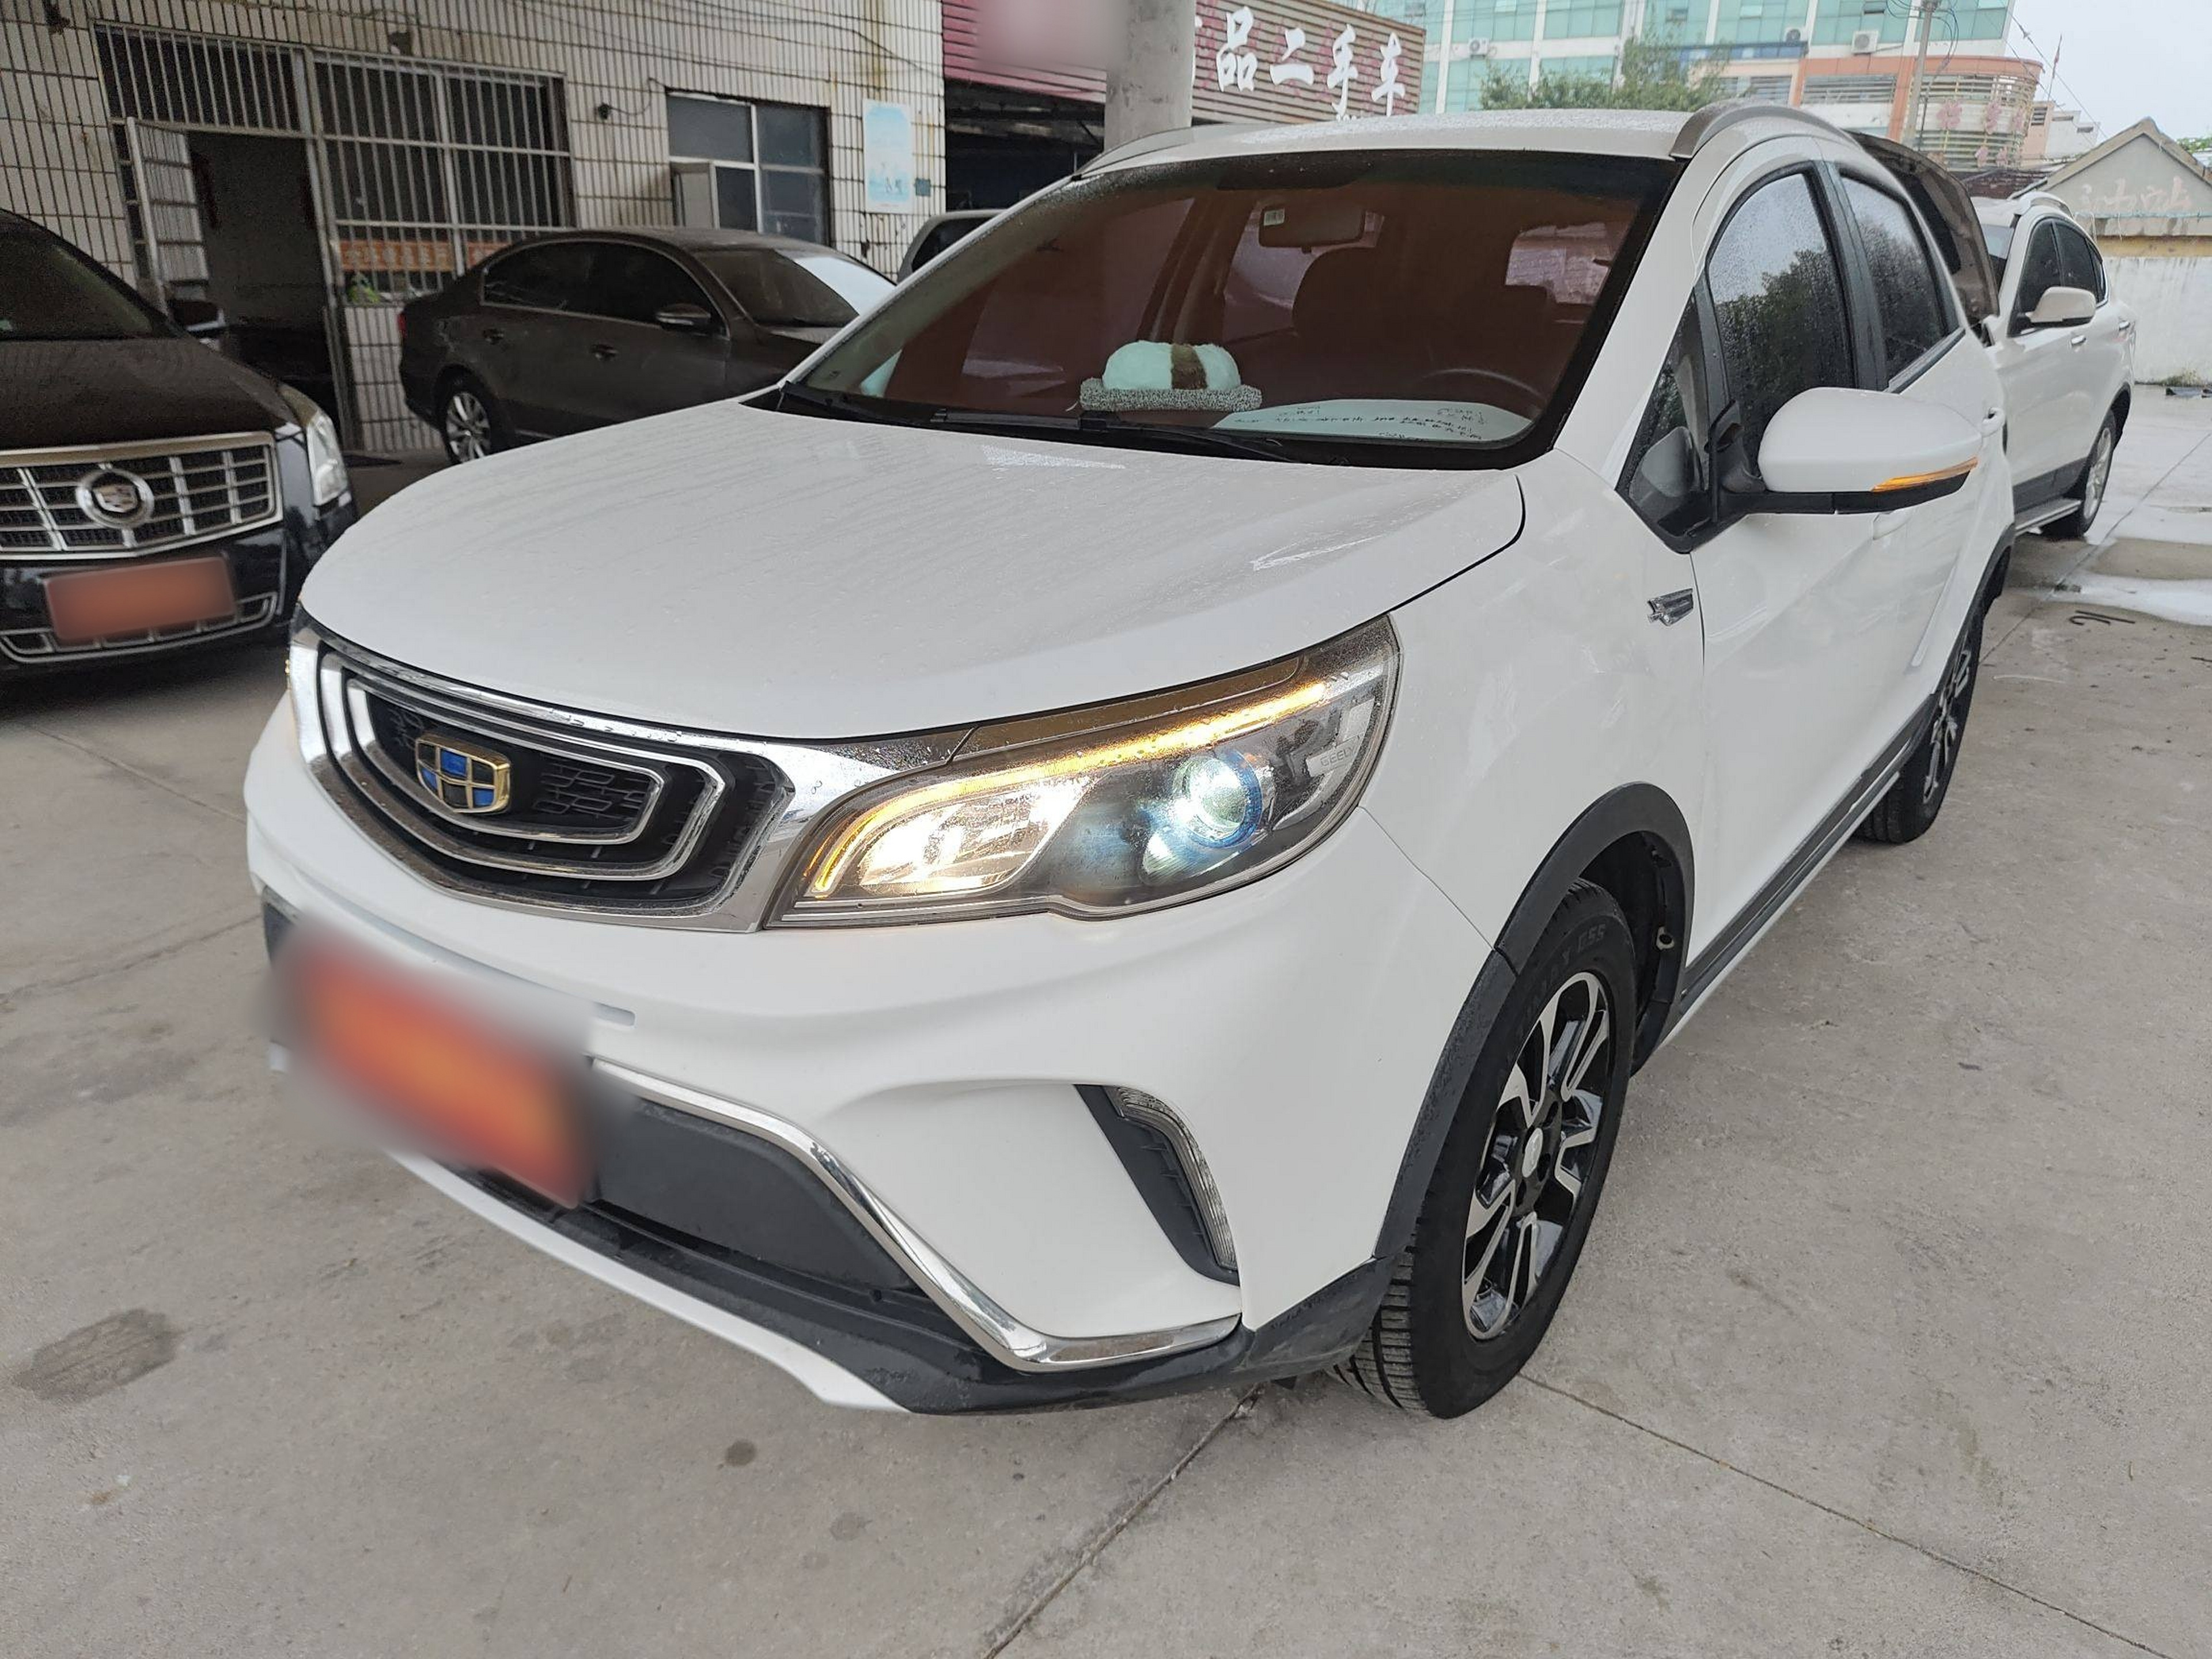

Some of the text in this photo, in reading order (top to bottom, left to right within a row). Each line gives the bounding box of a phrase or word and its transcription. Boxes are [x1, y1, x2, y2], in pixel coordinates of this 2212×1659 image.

[1195, 6, 1406, 117] 品二手车
[1320, 747, 1355, 767] GEELY
